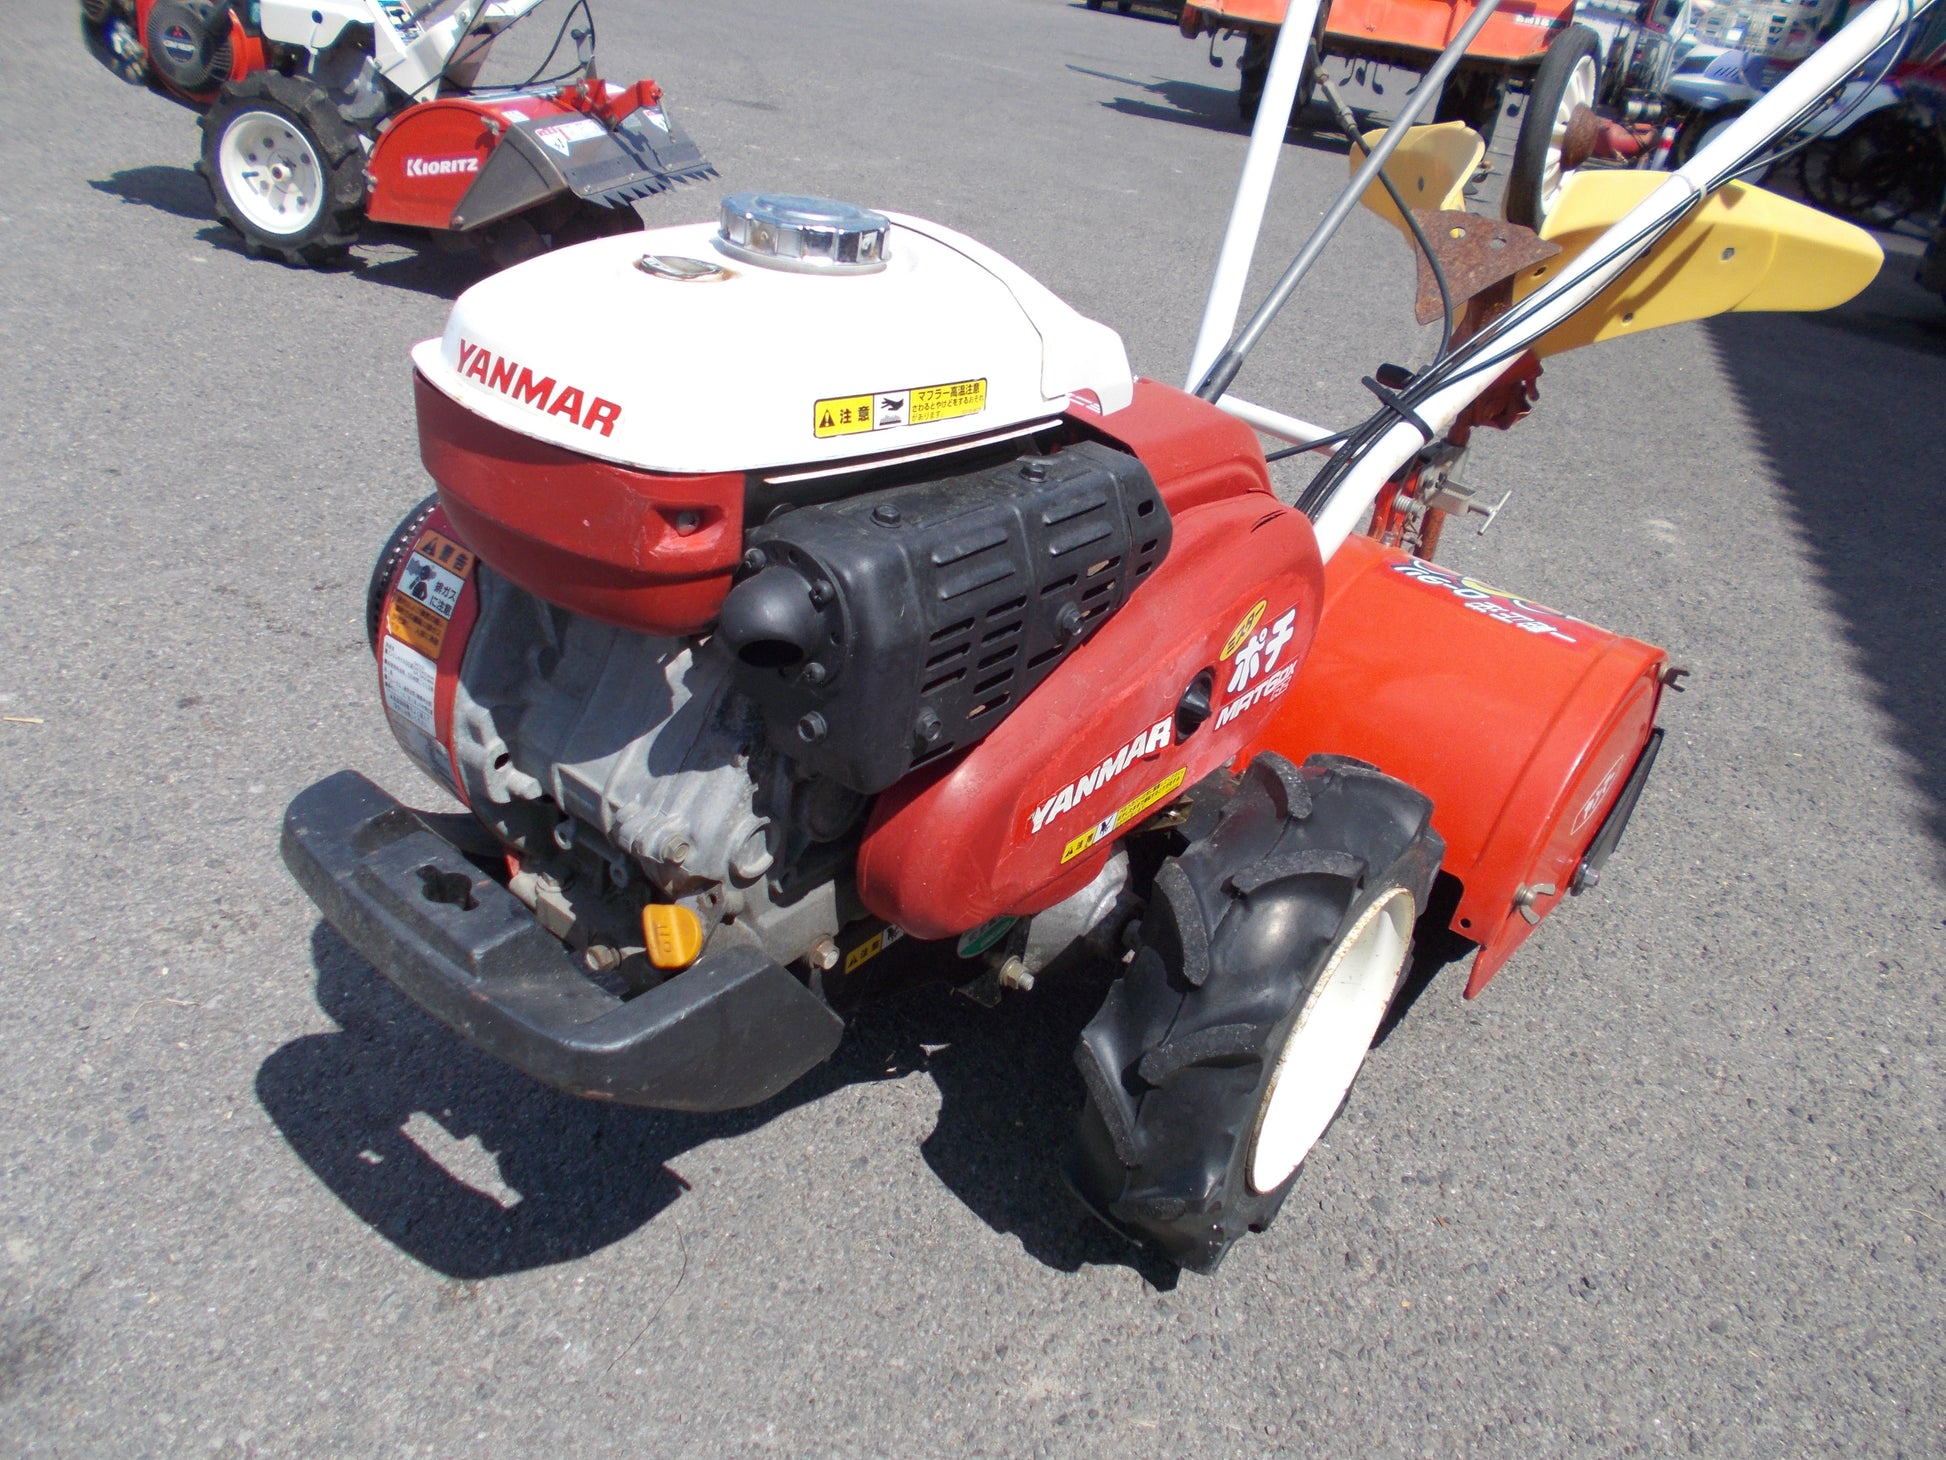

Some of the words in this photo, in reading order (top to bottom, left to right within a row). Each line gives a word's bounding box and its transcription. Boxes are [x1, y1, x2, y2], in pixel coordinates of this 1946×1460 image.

[406, 158, 479, 177] KIORITZ
[456, 338, 623, 438] YANMAR
[839, 406, 870, 425] 注意
[1227, 608, 1296, 693] ポチ
[1031, 716, 1173, 834] YANMAR
